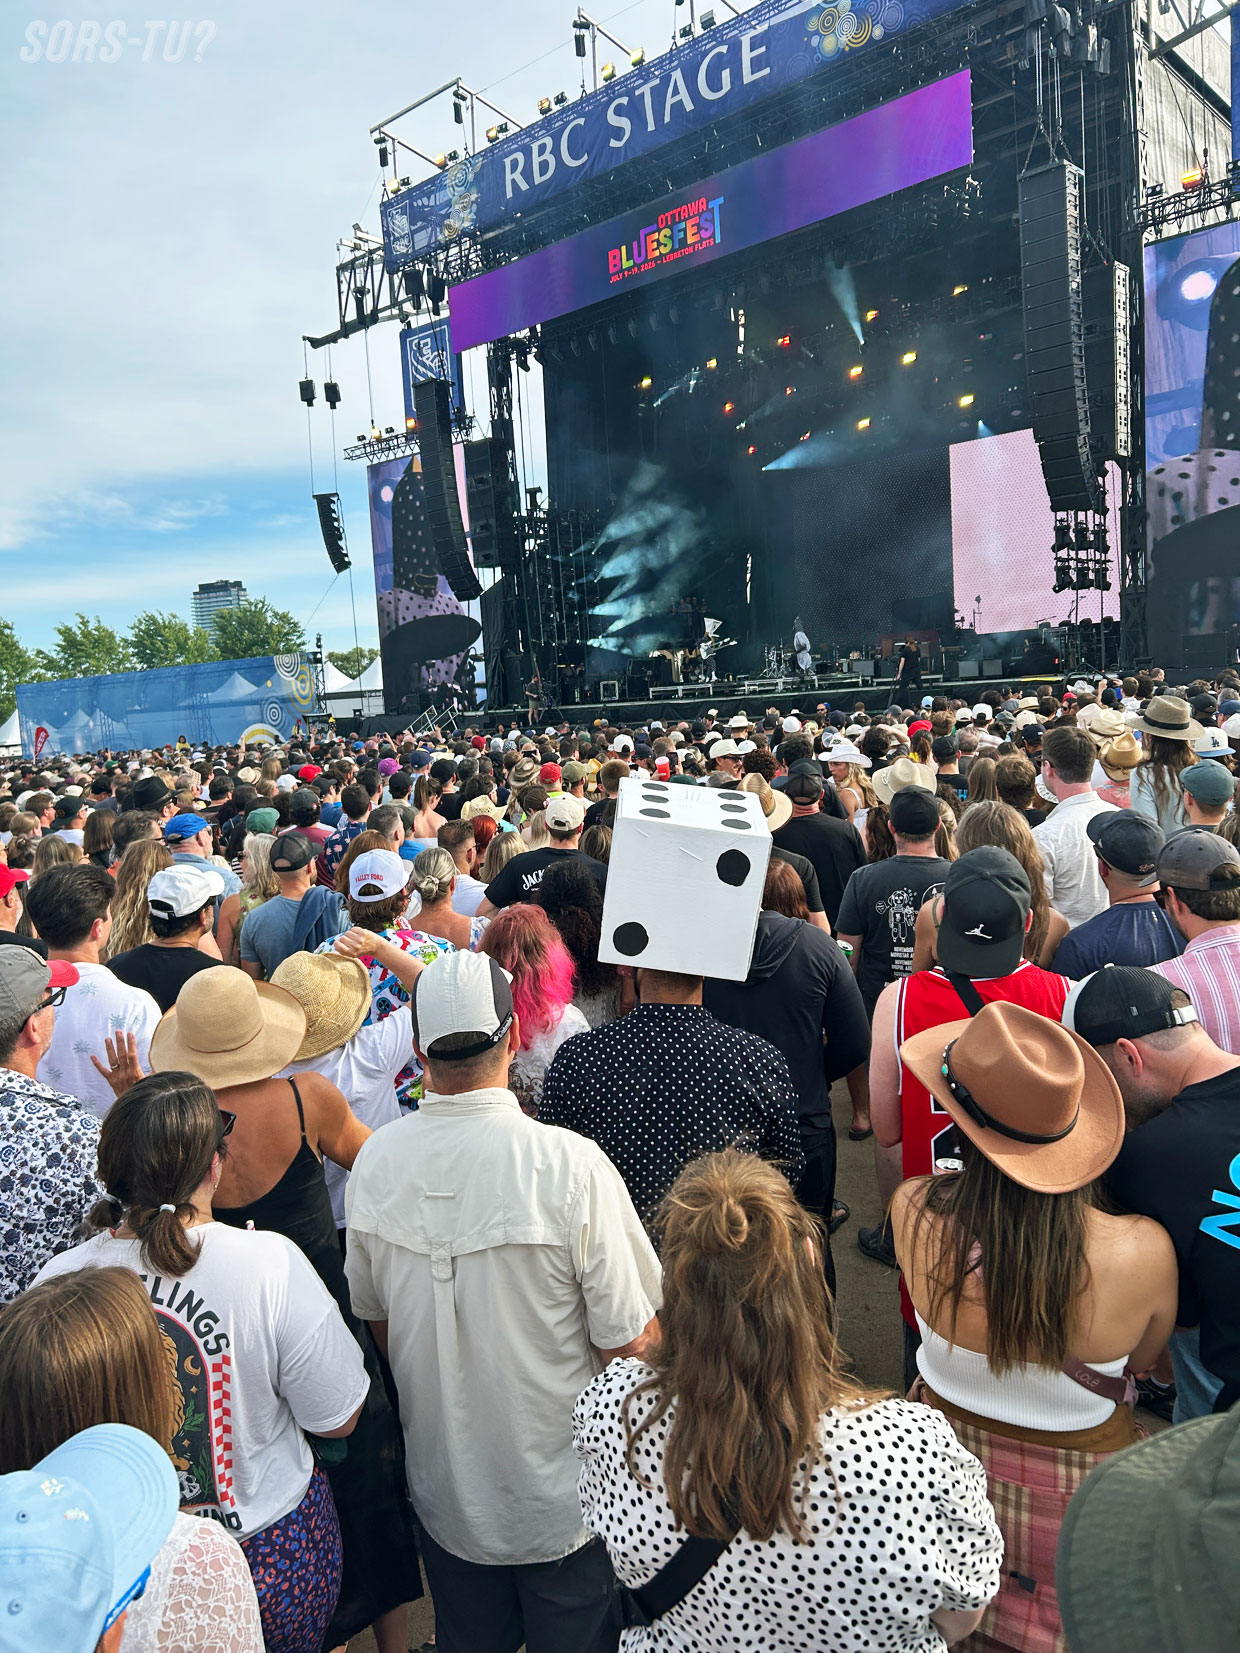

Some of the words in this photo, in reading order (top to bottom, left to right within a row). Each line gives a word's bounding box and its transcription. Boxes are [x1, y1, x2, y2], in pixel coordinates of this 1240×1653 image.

[503, 117, 589, 199] RBC
[606, 25, 771, 148] STAGE
[658, 197, 707, 228] OTTAWA
[392, 235, 411, 250] RBC
[608, 196, 724, 274] BLUESFEST
[610, 273, 623, 283] JULY
[641, 261, 656, 272] 2026
[694, 238, 715, 252] FLATS
[1211, 736, 1220, 748] LA
[522, 865, 551, 890] JACK
[139, 1273, 230, 1357] LINGS
